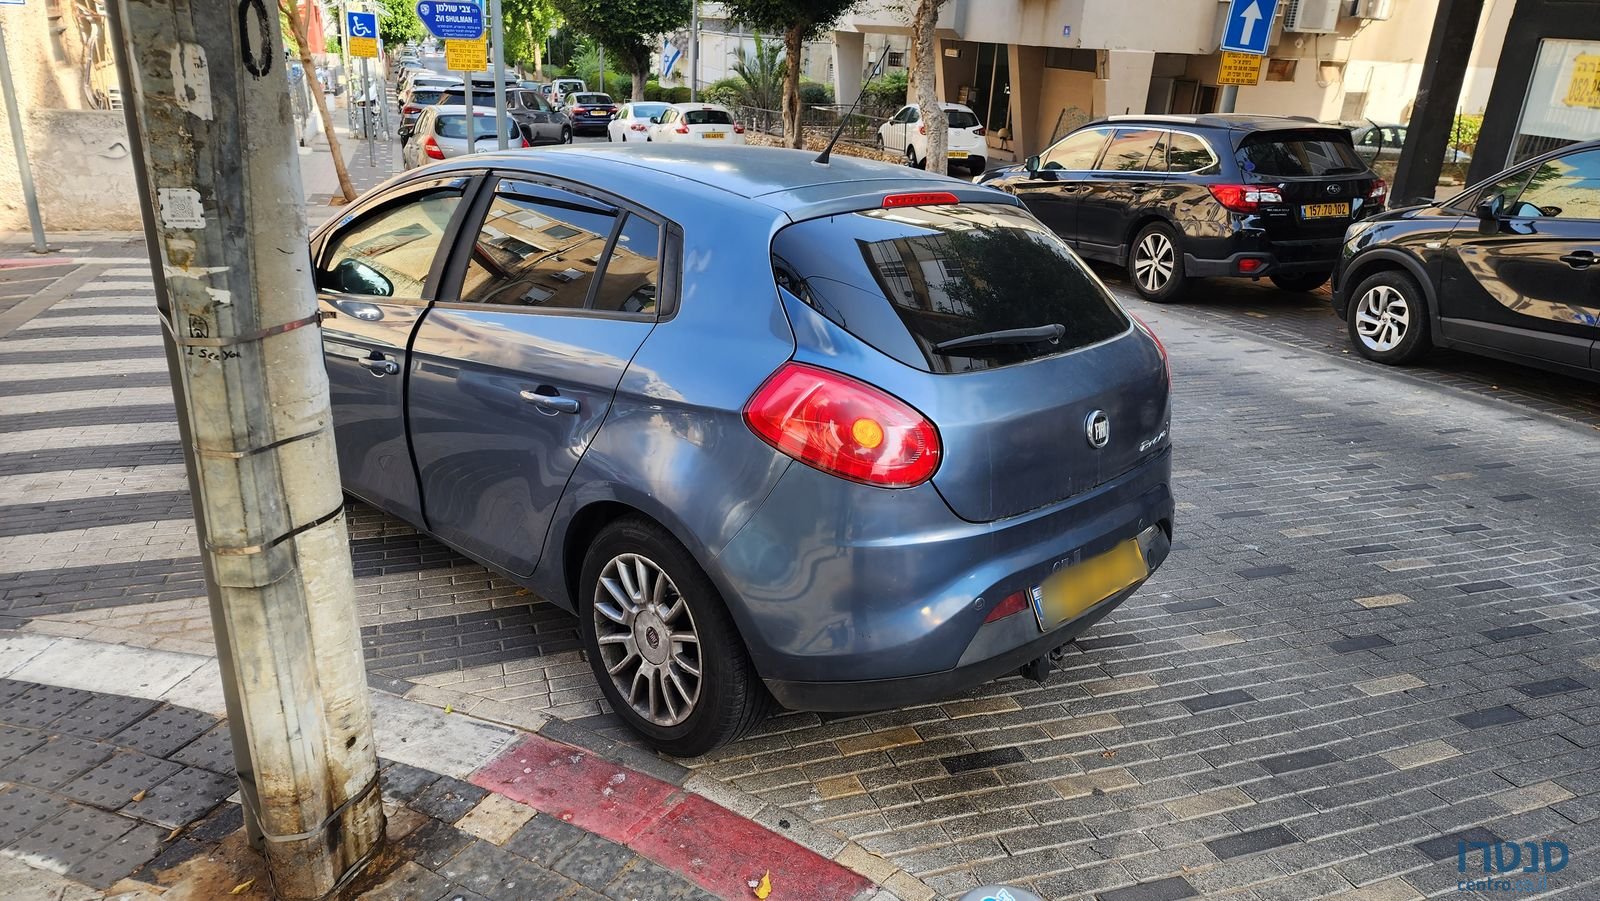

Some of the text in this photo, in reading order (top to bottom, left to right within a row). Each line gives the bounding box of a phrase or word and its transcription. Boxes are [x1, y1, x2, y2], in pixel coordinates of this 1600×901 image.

[435, 3, 457, 14] שולמן
[459, 5, 471, 13] צבי
[435, 14, 445, 22] ZVI
[445, 15, 473, 23] SHULMAN
[186, 345, 194, 355] I
